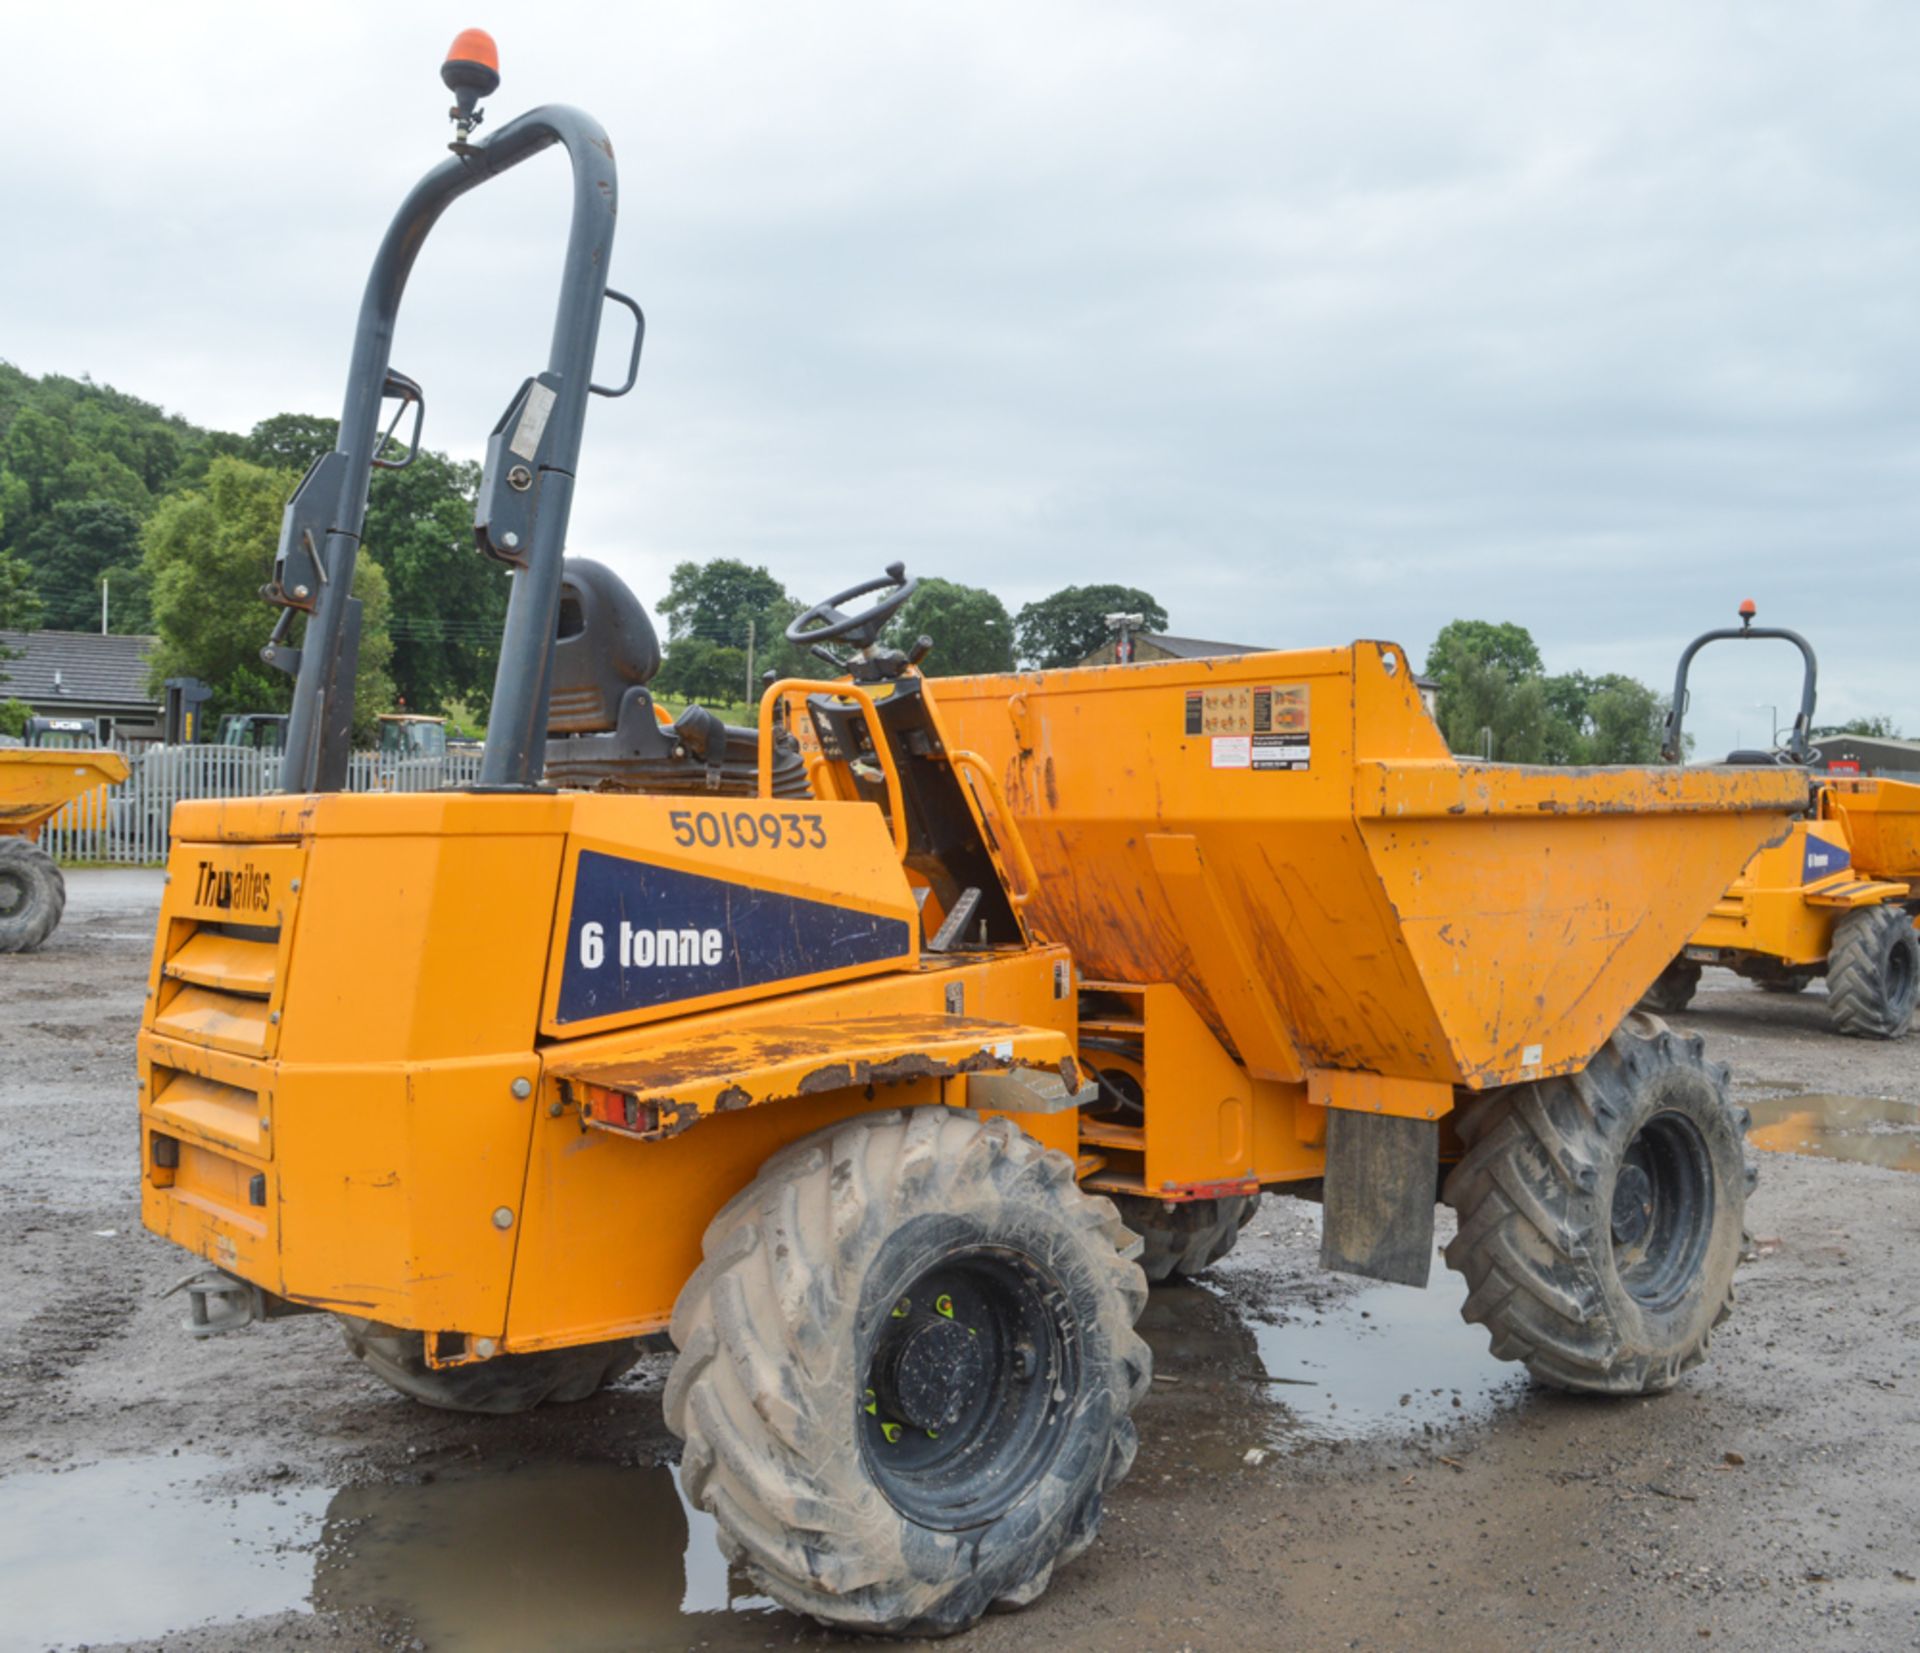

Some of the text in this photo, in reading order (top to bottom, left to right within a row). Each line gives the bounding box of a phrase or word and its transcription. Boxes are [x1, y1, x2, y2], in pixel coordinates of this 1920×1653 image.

[669, 811, 827, 849] 5010933
[580, 920, 723, 969] 6 tonne
